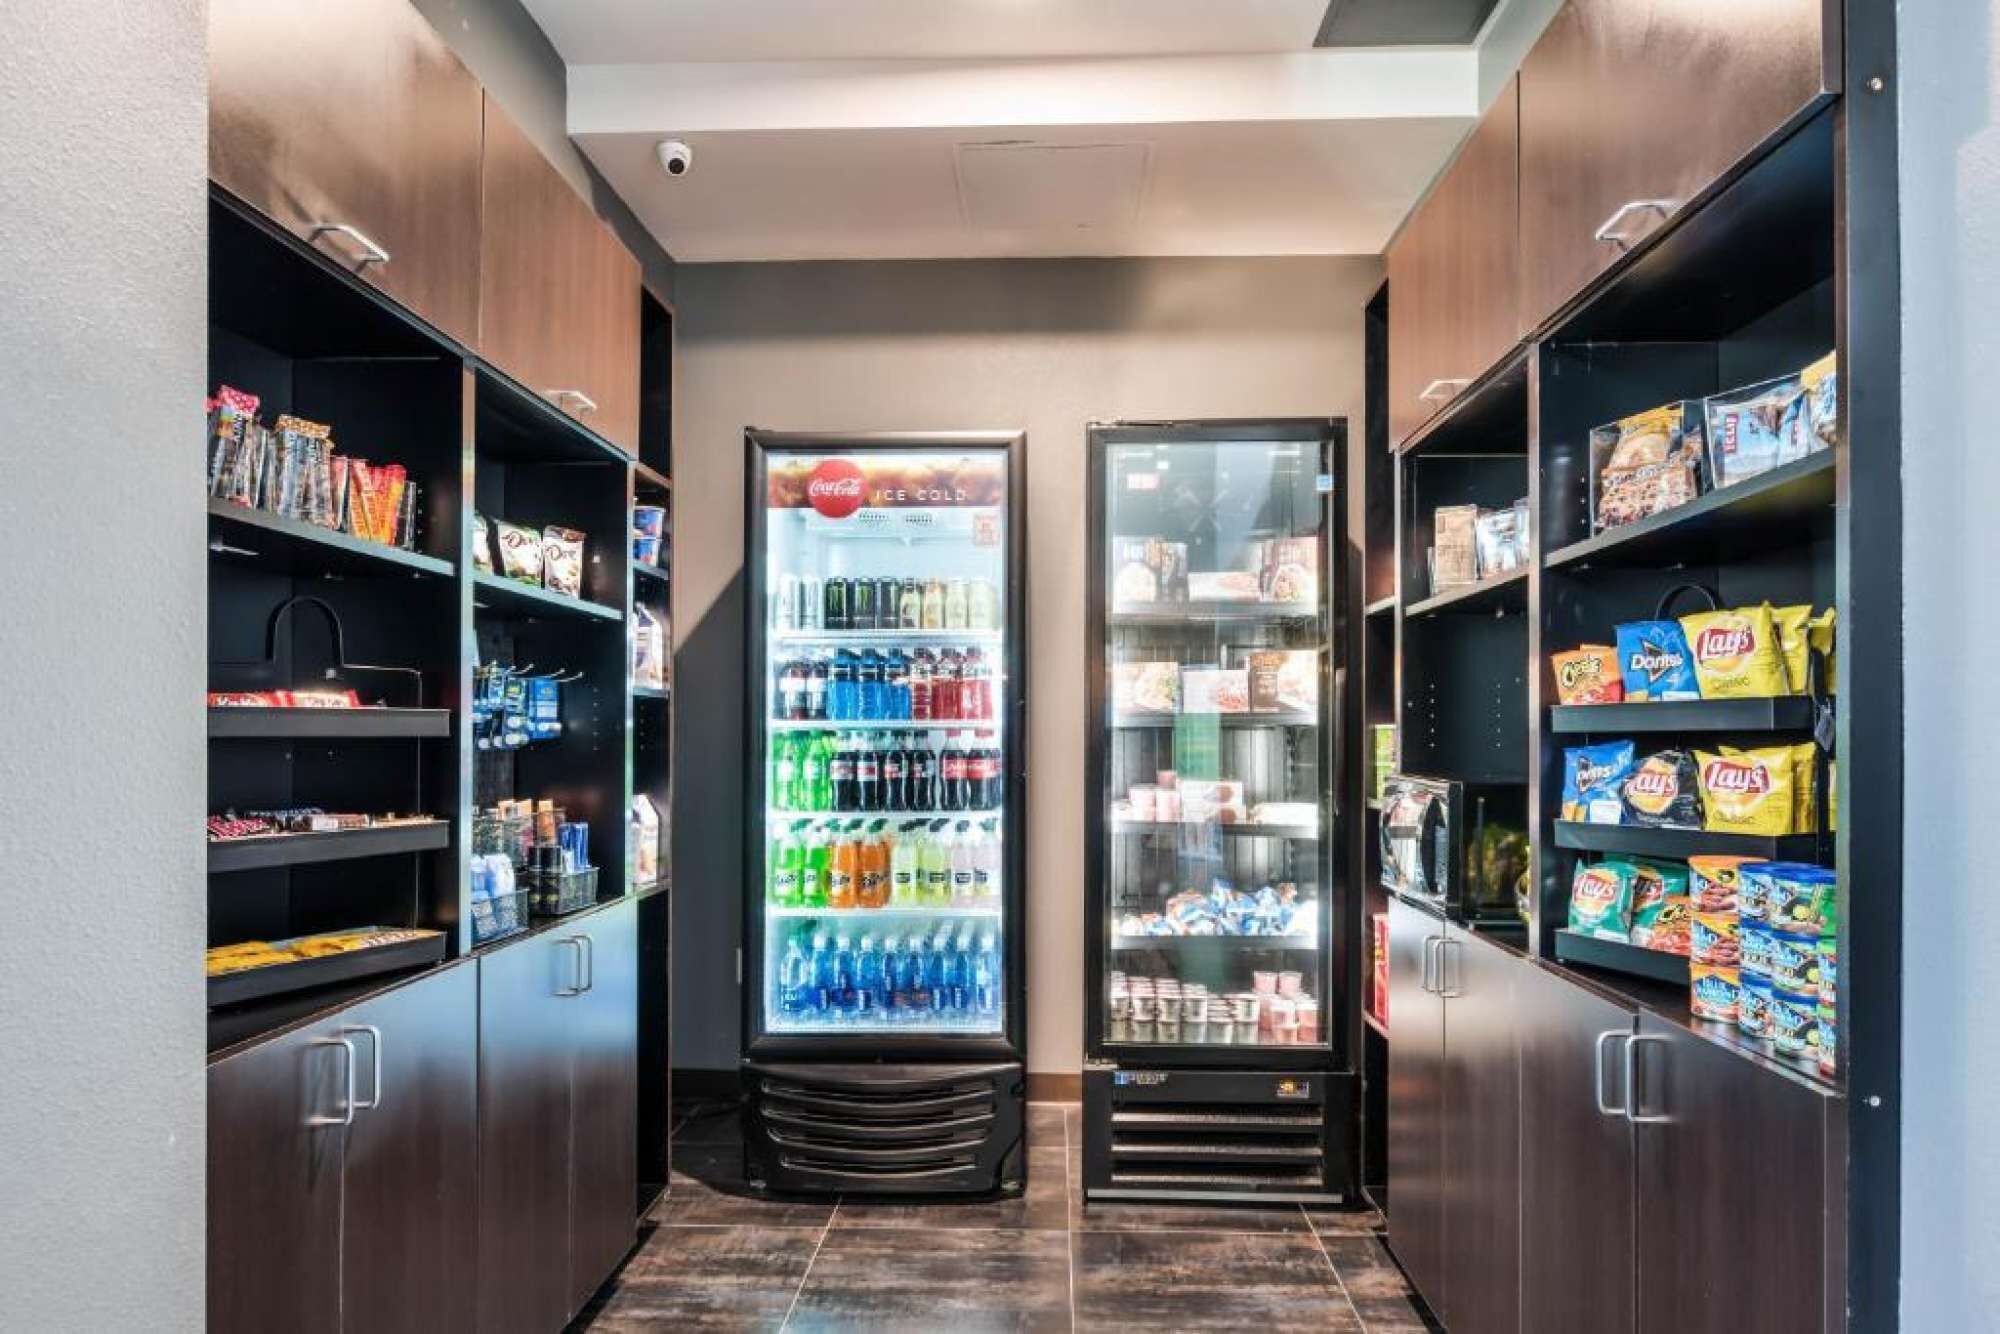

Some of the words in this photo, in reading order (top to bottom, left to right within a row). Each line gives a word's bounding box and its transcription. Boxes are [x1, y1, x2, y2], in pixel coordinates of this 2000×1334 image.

[809, 478, 861, 497] Coca-Cola
[876, 489, 906, 501] ICE
[917, 489, 967, 501] COLD
[1630, 652, 1683, 671] Doritos
